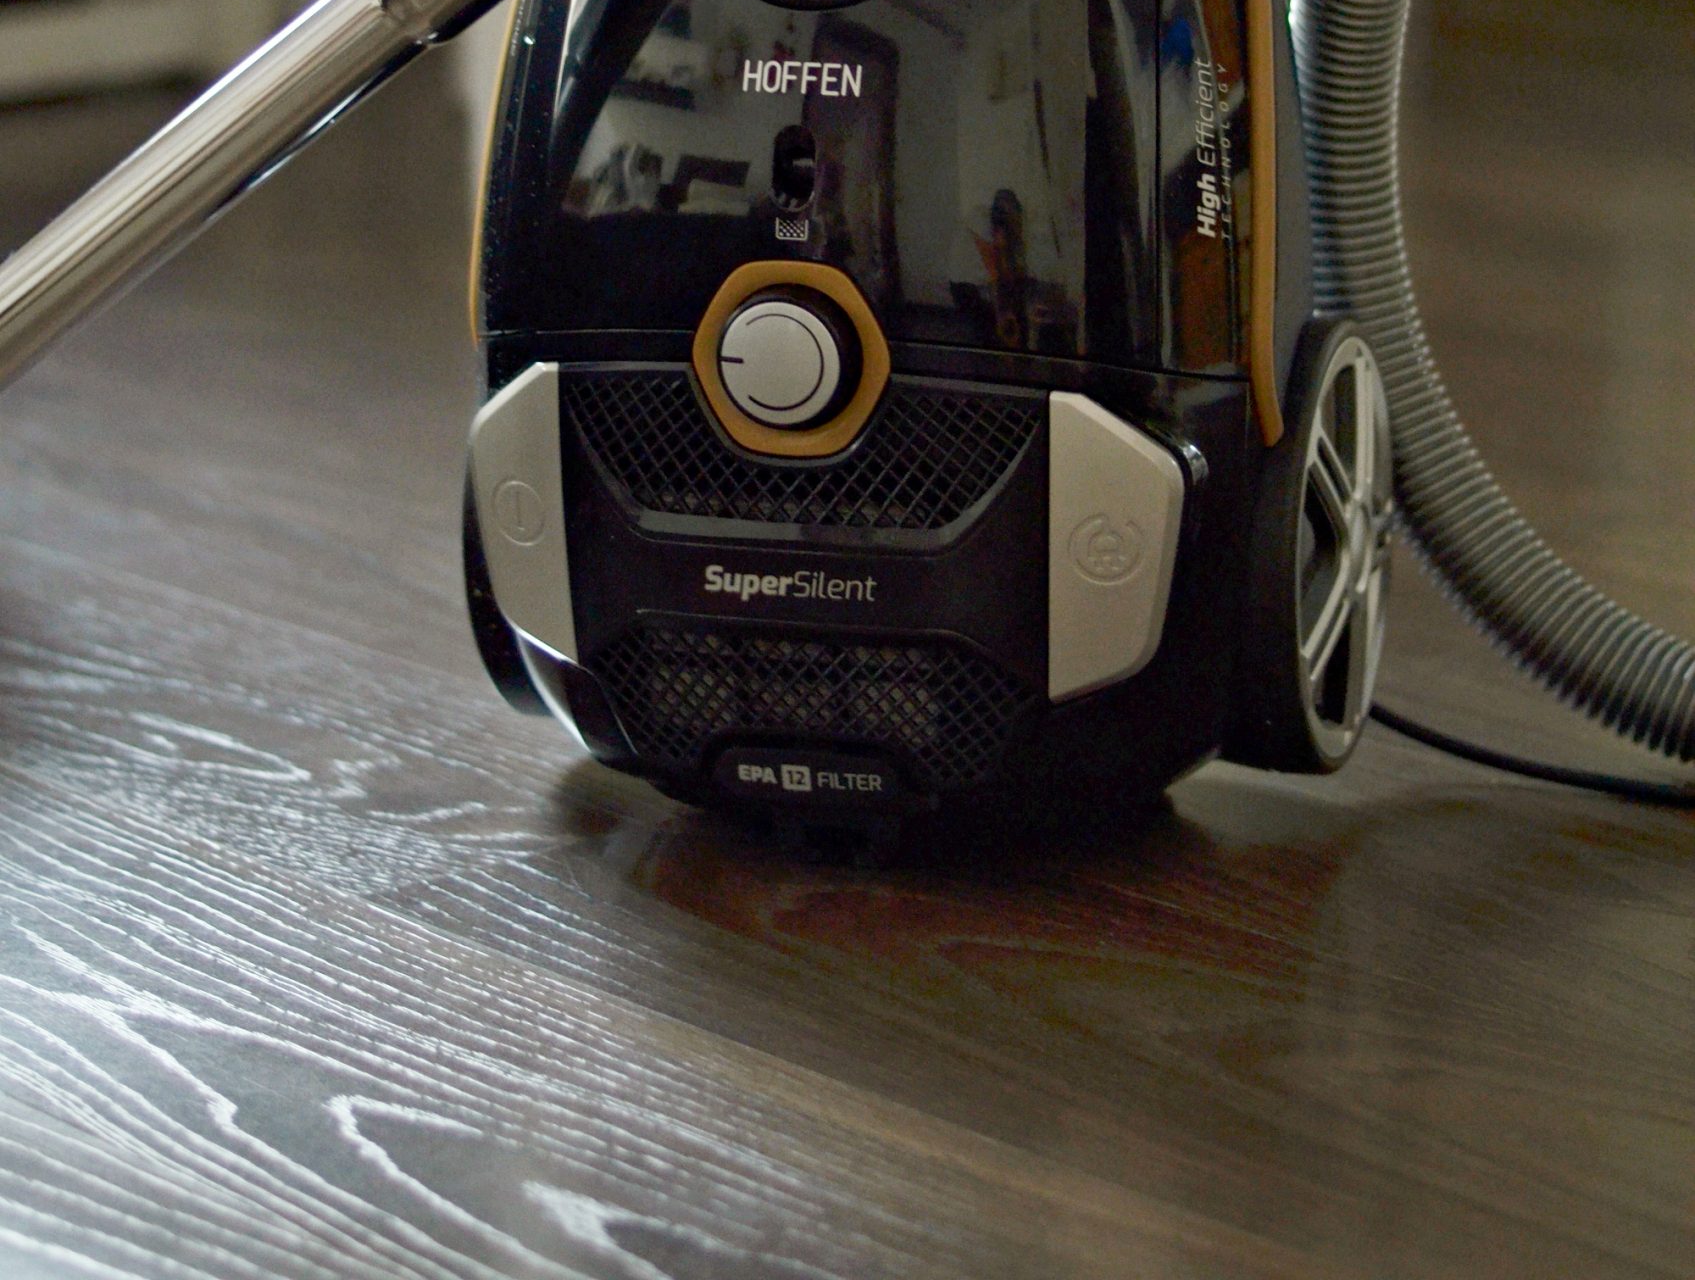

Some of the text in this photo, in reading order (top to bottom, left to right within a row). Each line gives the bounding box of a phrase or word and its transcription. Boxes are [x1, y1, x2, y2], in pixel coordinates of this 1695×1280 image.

[742, 59, 862, 97] HOFFEN
[1195, 58, 1221, 238] High Efficient
[1217, 63, 1233, 239] TECHNOLOGY
[704, 564, 877, 602] SuperSilent
[738, 763, 882, 791] EPA 12 FILTER
